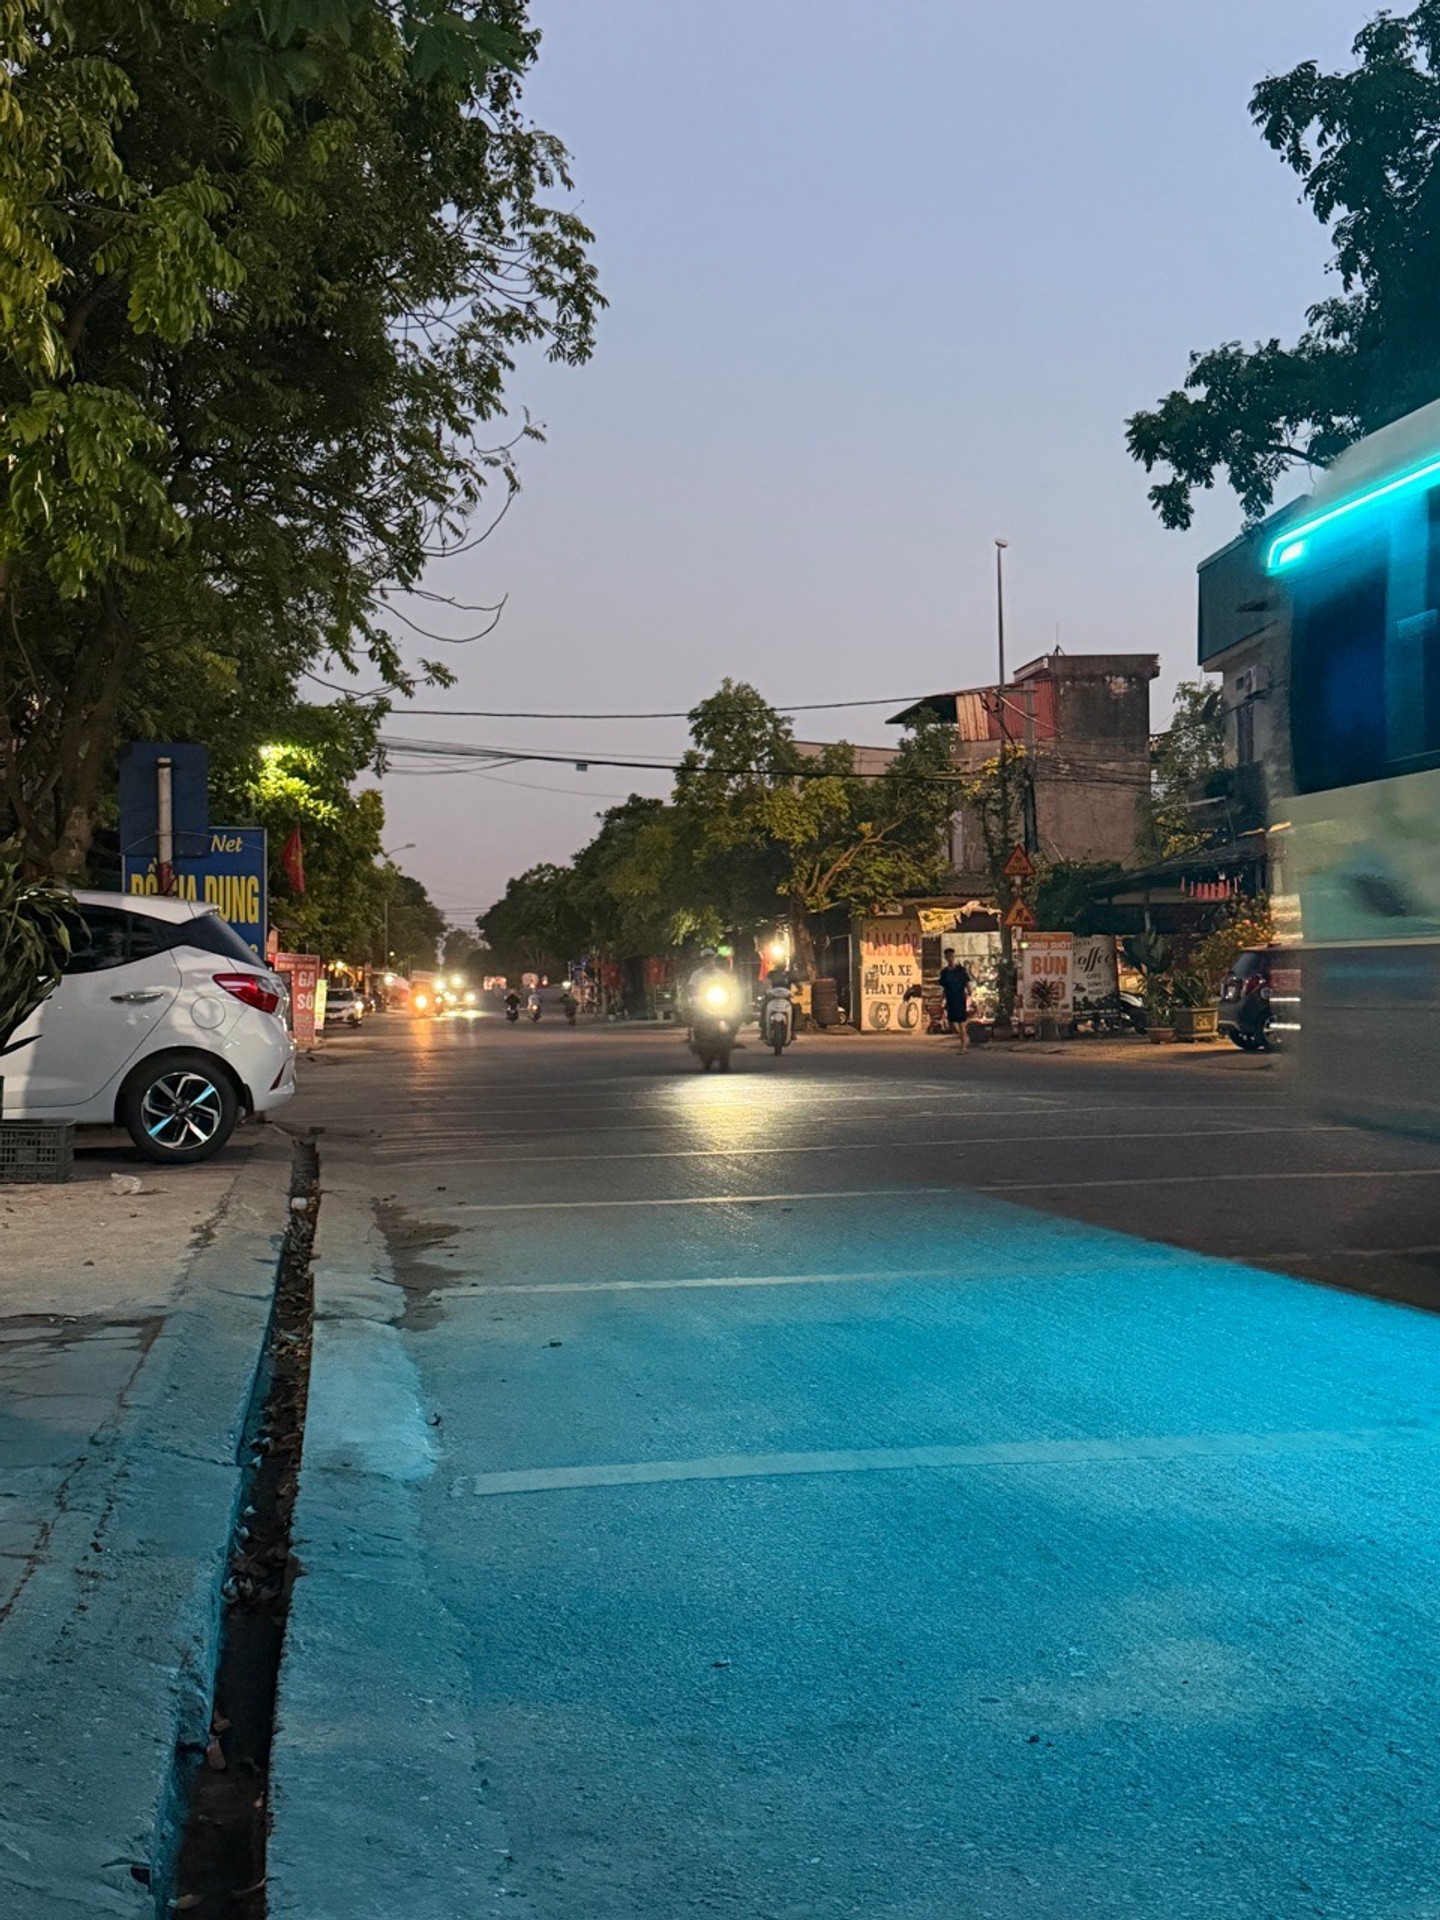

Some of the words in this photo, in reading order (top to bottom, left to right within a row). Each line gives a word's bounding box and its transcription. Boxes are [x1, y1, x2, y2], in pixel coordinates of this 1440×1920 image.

[210, 834, 243, 852] Net
[897, 964, 913, 976] XE
[1030, 952, 1068, 975] BÚN
